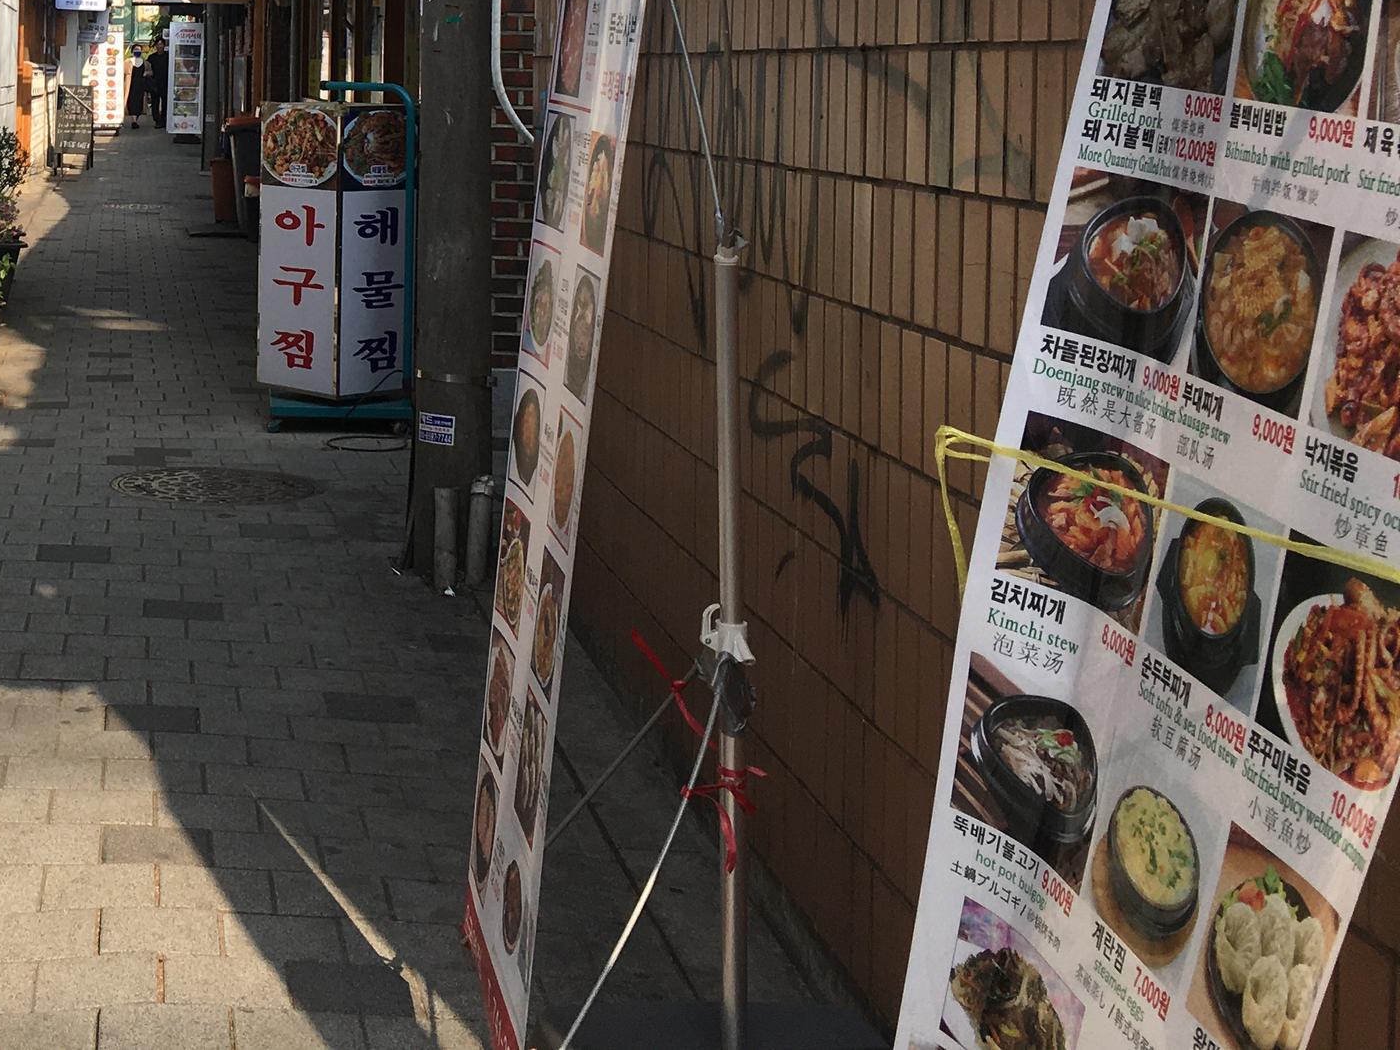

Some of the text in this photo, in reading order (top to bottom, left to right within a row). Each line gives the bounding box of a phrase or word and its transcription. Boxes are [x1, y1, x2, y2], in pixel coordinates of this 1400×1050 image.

[1088, 101, 1137, 126] Grilled
[1139, 112, 1164, 133] pork
[1090, 78, 1224, 123] 돼지불백 9,000원
[1081, 119, 1156, 154] 돼지불백
[1175, 137, 1218, 167] 12,000원
[1229, 102, 1288, 138] 불백비빔밥
[1307, 116, 1356, 148] 9,000원
[1363, 126, 1400, 158] 제육
[1077, 144, 1102, 168] More
[1103, 147, 1138, 173] Quantity
[1270, 149, 1291, 171] with
[1291, 155, 1326, 179] grilled
[1326, 163, 1351, 185] pork
[270, 205, 325, 369] 아구찜
[353, 207, 404, 373] 해물찜
[1032, 358, 1100, 395] Doenjang
[1101, 381, 1125, 400] stew
[1040, 333, 1137, 384] 차돌된장찌개
[1182, 381, 1225, 423] 부대찌개
[1210, 425, 1232, 446] stew
[1305, 435, 1359, 483] 낙지볶음
[1300, 469, 1319, 495] Stir
[1320, 478, 1349, 508] fried
[1349, 497, 1381, 526] spicy
[987, 607, 1080, 656] Kimchi stew
[990, 578, 1137, 667] 김치찌개 8,000원
[1141, 653, 1247, 755] 순두부찌개 8,000원
[1218, 744, 1238, 769] stew
[953, 814, 1040, 880] 뚝배기불고기
[975, 848, 997, 872] hot
[997, 865, 1017, 885] pot
[1092, 920, 1127, 975] 계란찜
